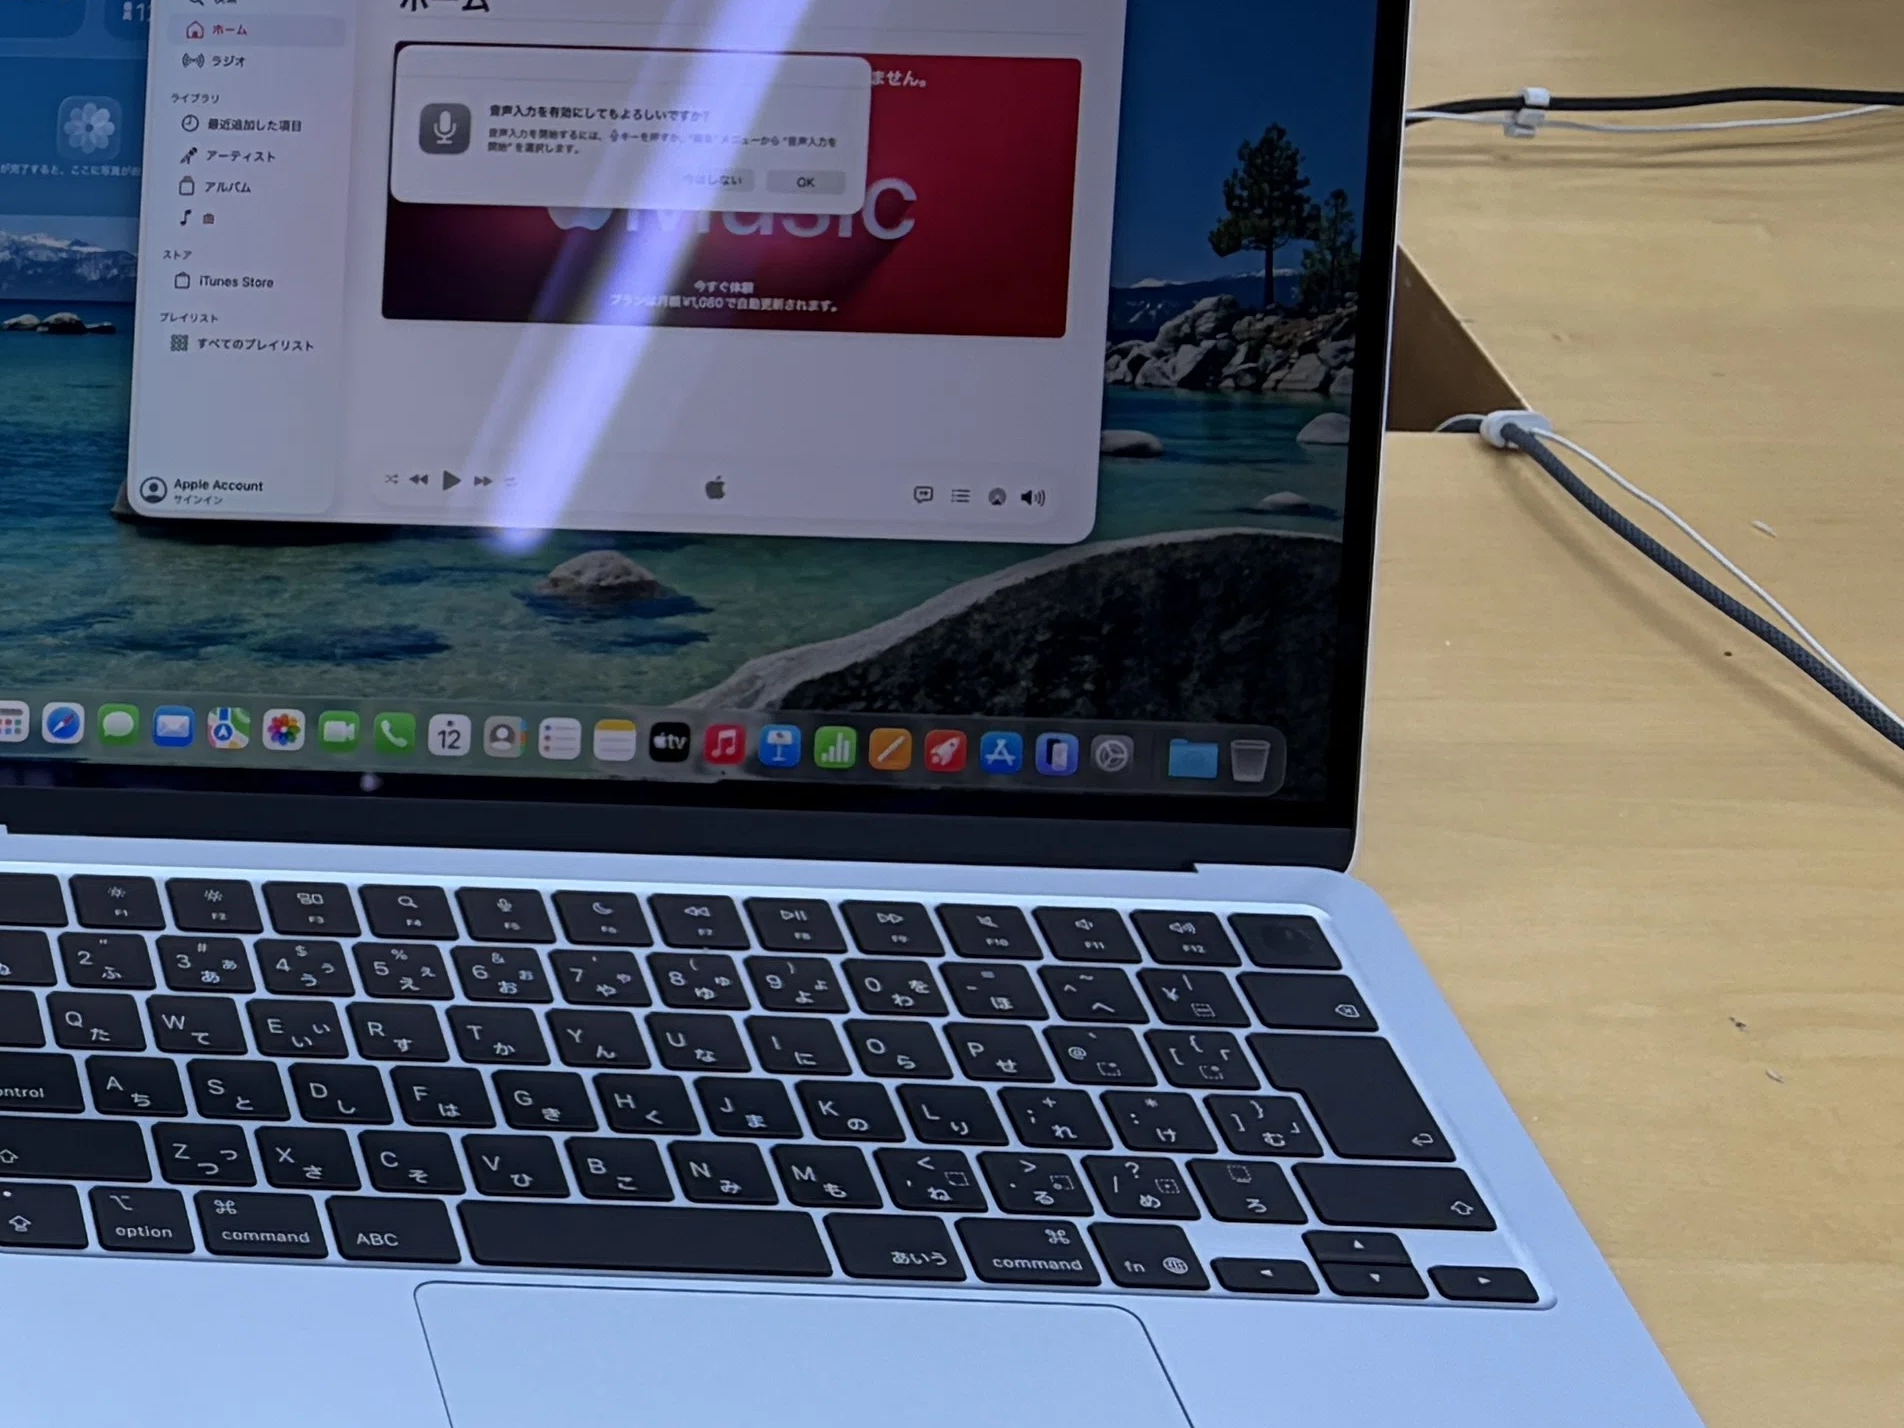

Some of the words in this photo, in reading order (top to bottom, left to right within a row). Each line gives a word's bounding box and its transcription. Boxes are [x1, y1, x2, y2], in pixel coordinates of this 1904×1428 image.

[212, 24, 248, 37] ホーム
[211, 55, 246, 69] ラジオ
[170, 92, 220, 105] ライブラリ
[206, 117, 303, 133] 最近追加した項目
[205, 149, 276, 165] アーティスト
[204, 180, 252, 195] アルバム
[796, 176, 816, 190] OK
[162, 249, 193, 261] ストア
[199, 274, 239, 289] iTunes
[242, 275, 275, 289] Store
[159, 311, 220, 324] プレイリスト
[197, 337, 315, 352] すべてのプレイリスト
[173, 478, 210, 492] Apple
[212, 479, 264, 492] Account
[173, 494, 224, 506] サインイン
[437, 728, 461, 750] 12
[114, 1224, 174, 1240] option
[221, 1228, 312, 1246] command
[356, 1232, 400, 1248] ABC
[890, 1250, 948, 1266] あいう
[992, 1256, 1084, 1272] command
[1123, 1260, 1146, 1274] fn
